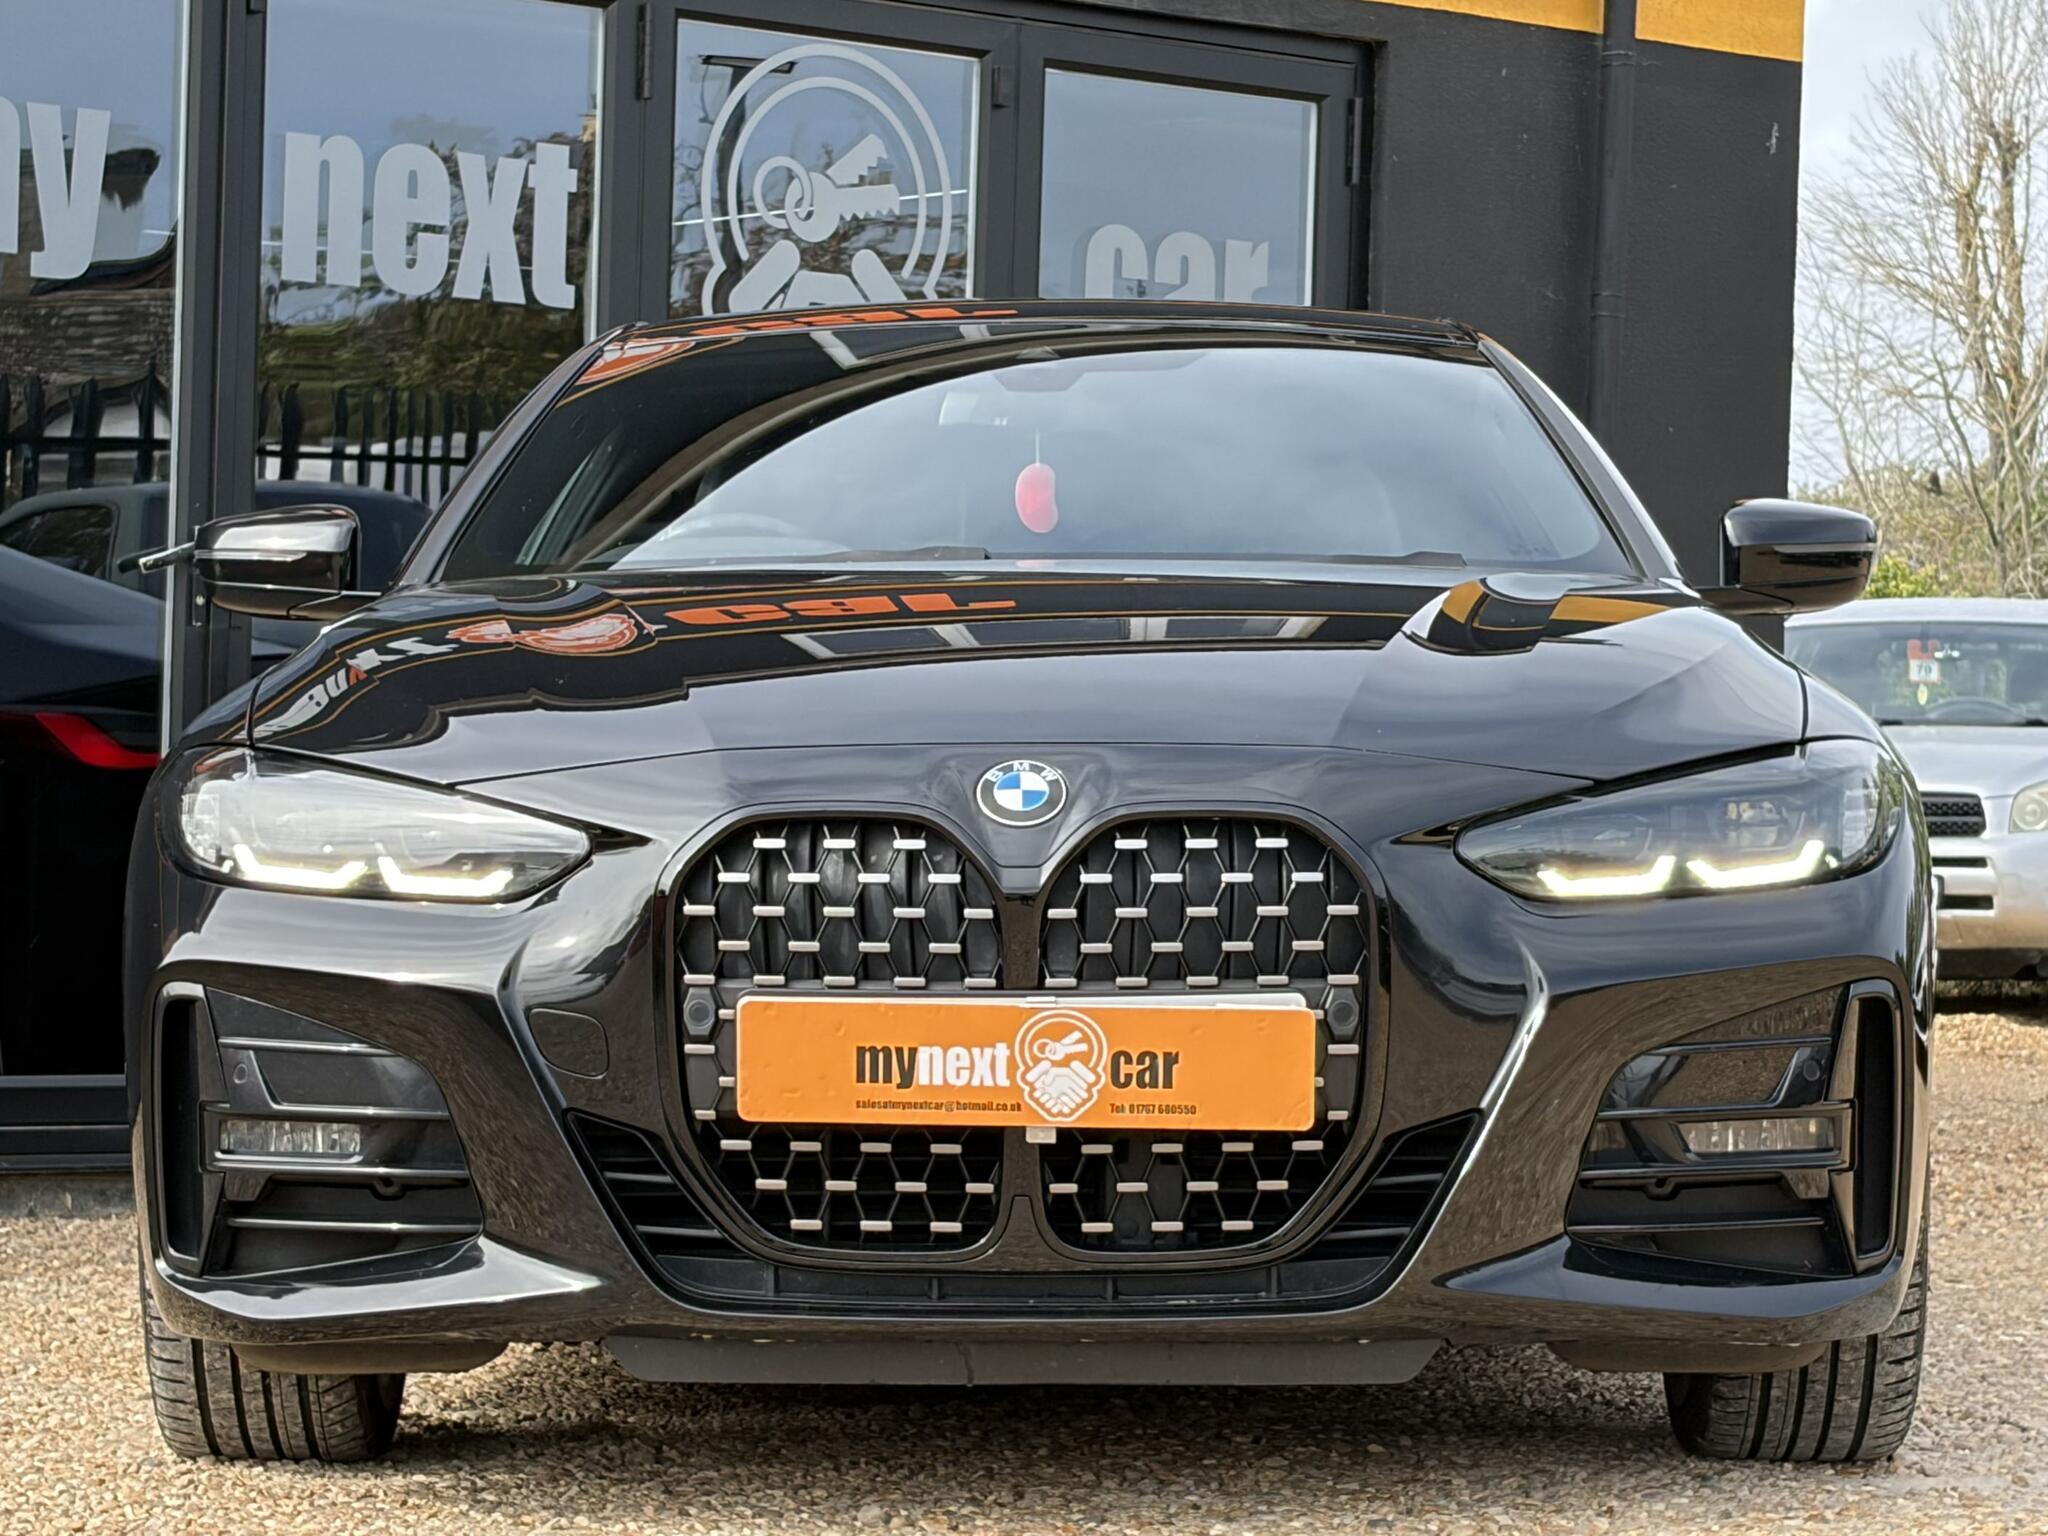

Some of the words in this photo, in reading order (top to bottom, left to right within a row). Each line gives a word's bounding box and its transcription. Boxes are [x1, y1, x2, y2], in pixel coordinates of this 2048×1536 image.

[281, 131, 577, 309] next
[986, 762, 1058, 782] BMW
[1110, 1050, 1180, 1089] car
